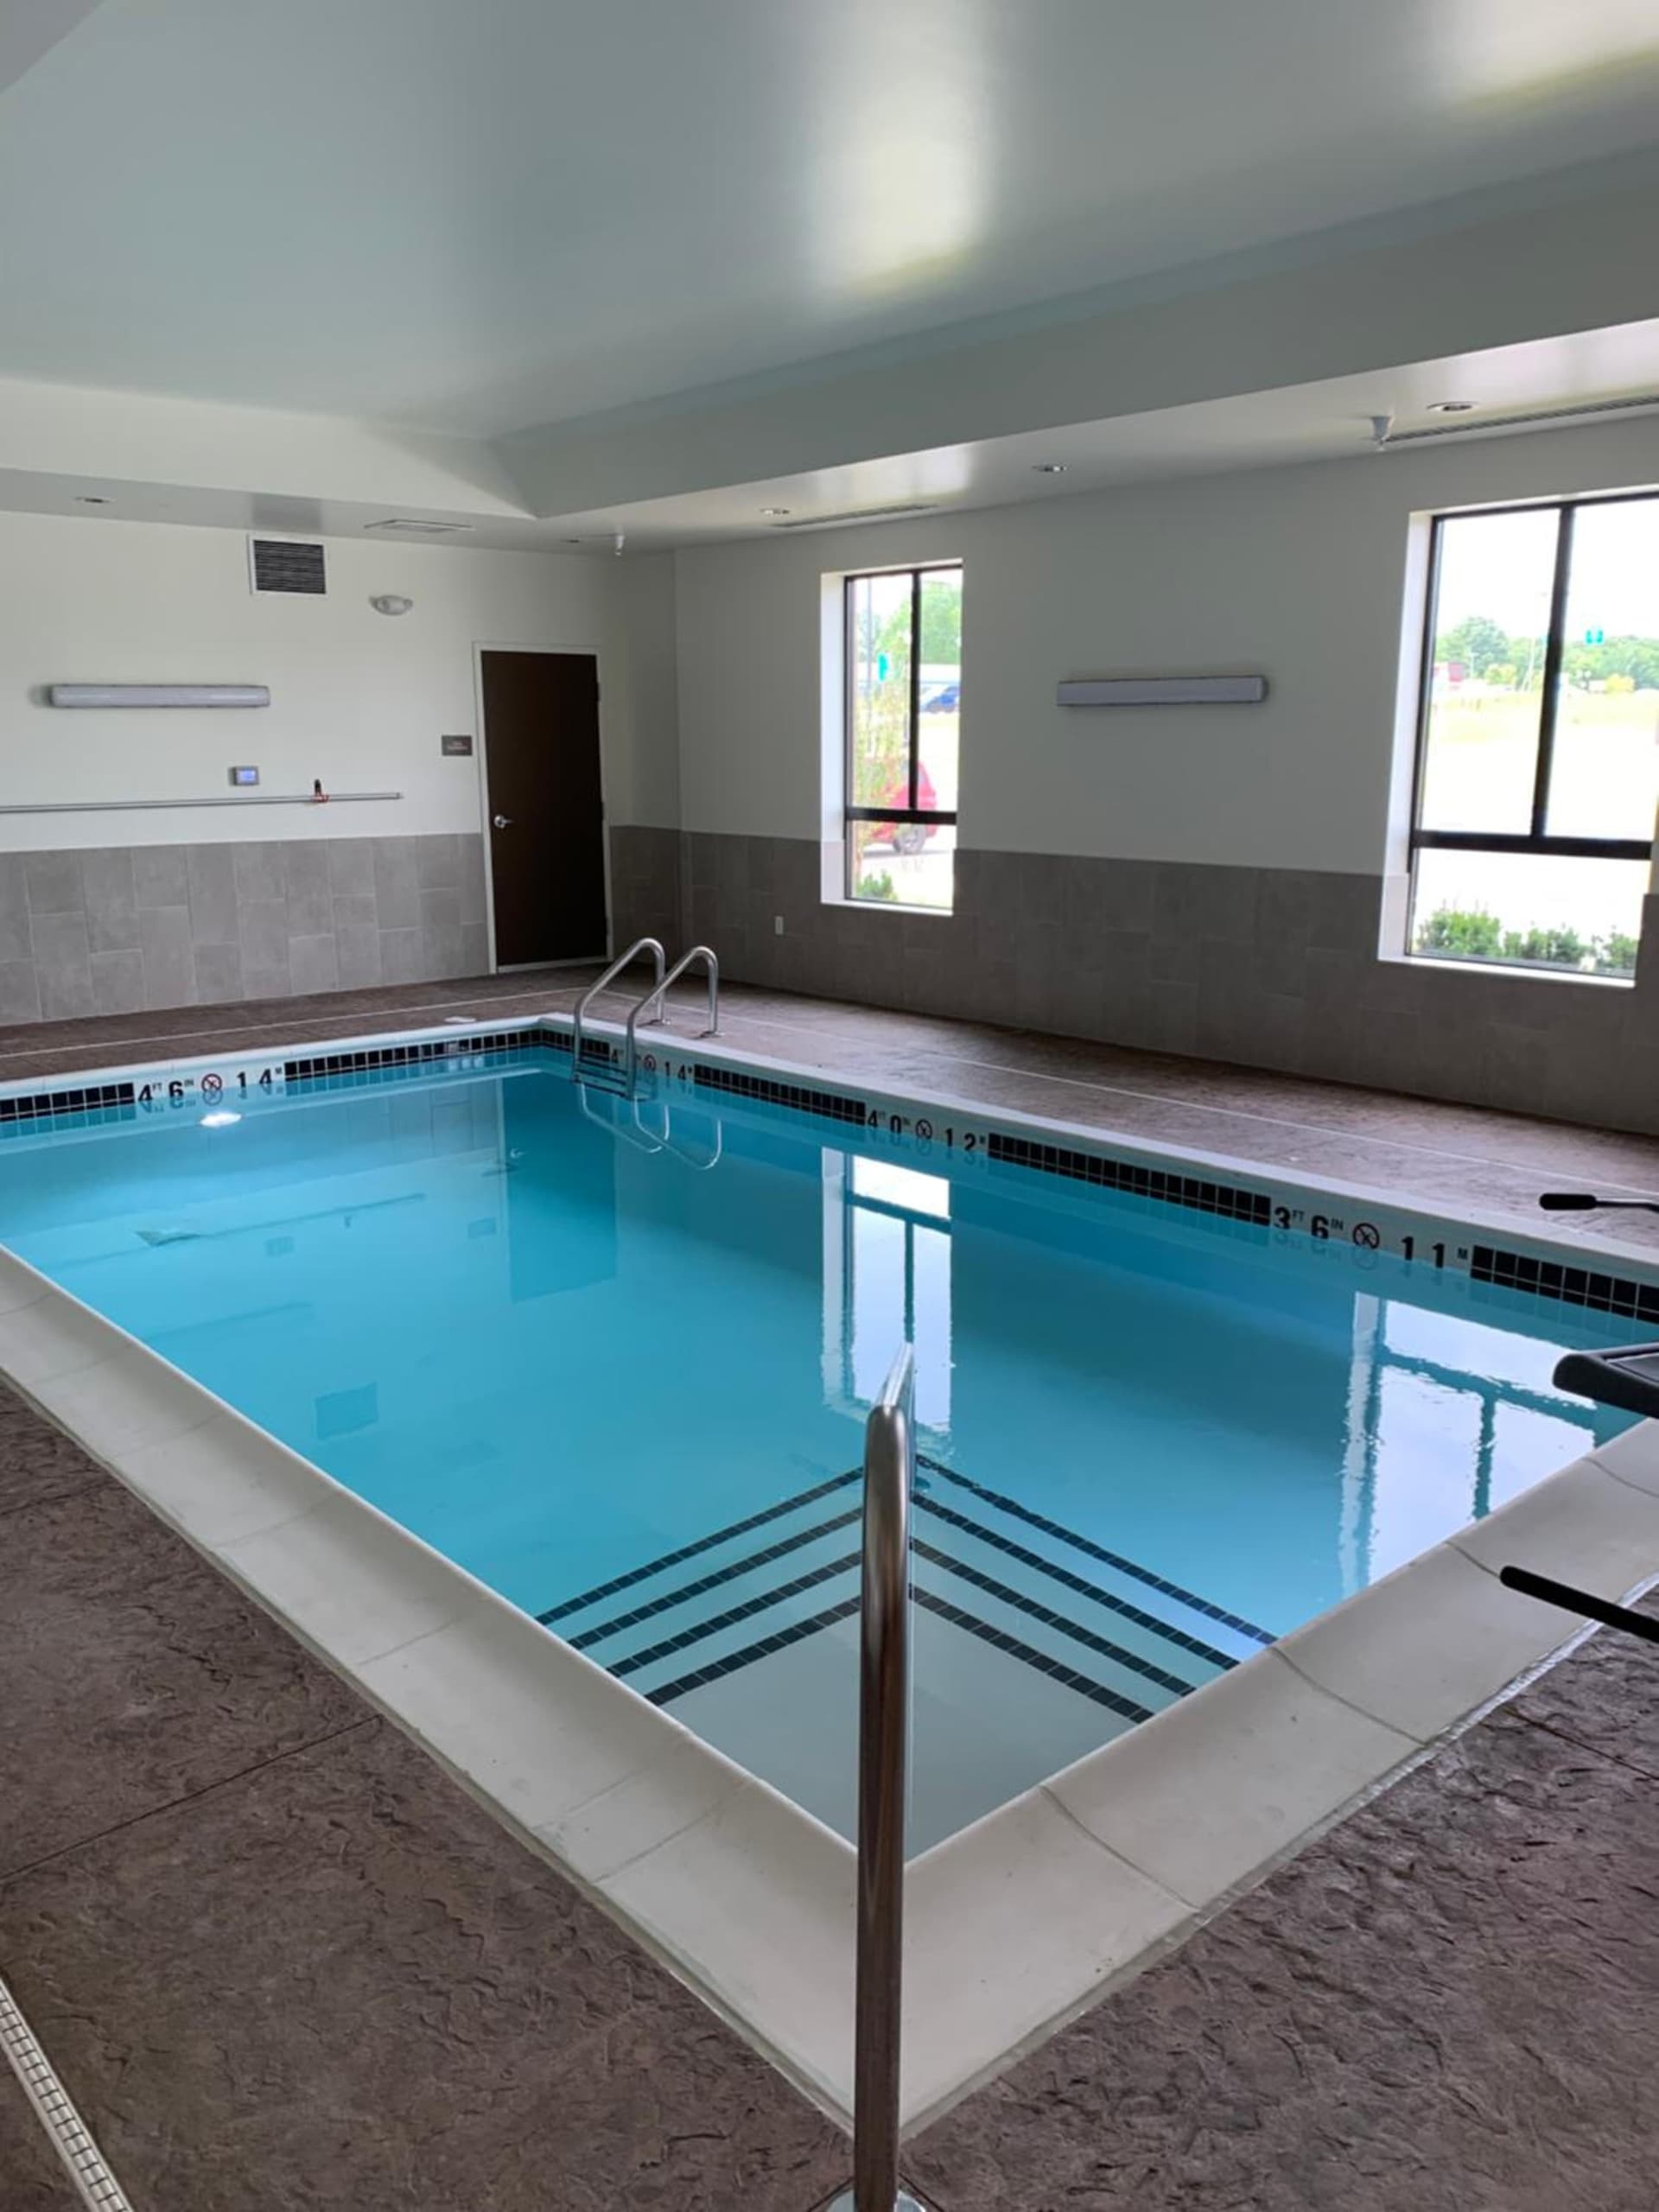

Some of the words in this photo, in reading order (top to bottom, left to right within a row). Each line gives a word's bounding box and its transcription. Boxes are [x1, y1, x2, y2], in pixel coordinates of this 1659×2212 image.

[138, 1084, 152, 1101] 4
[168, 1081, 183, 1098] 6
[868, 1110, 878, 1128] 4
[1274, 1206, 1291, 1230] 3
[1311, 1215, 1329, 1239] 6
